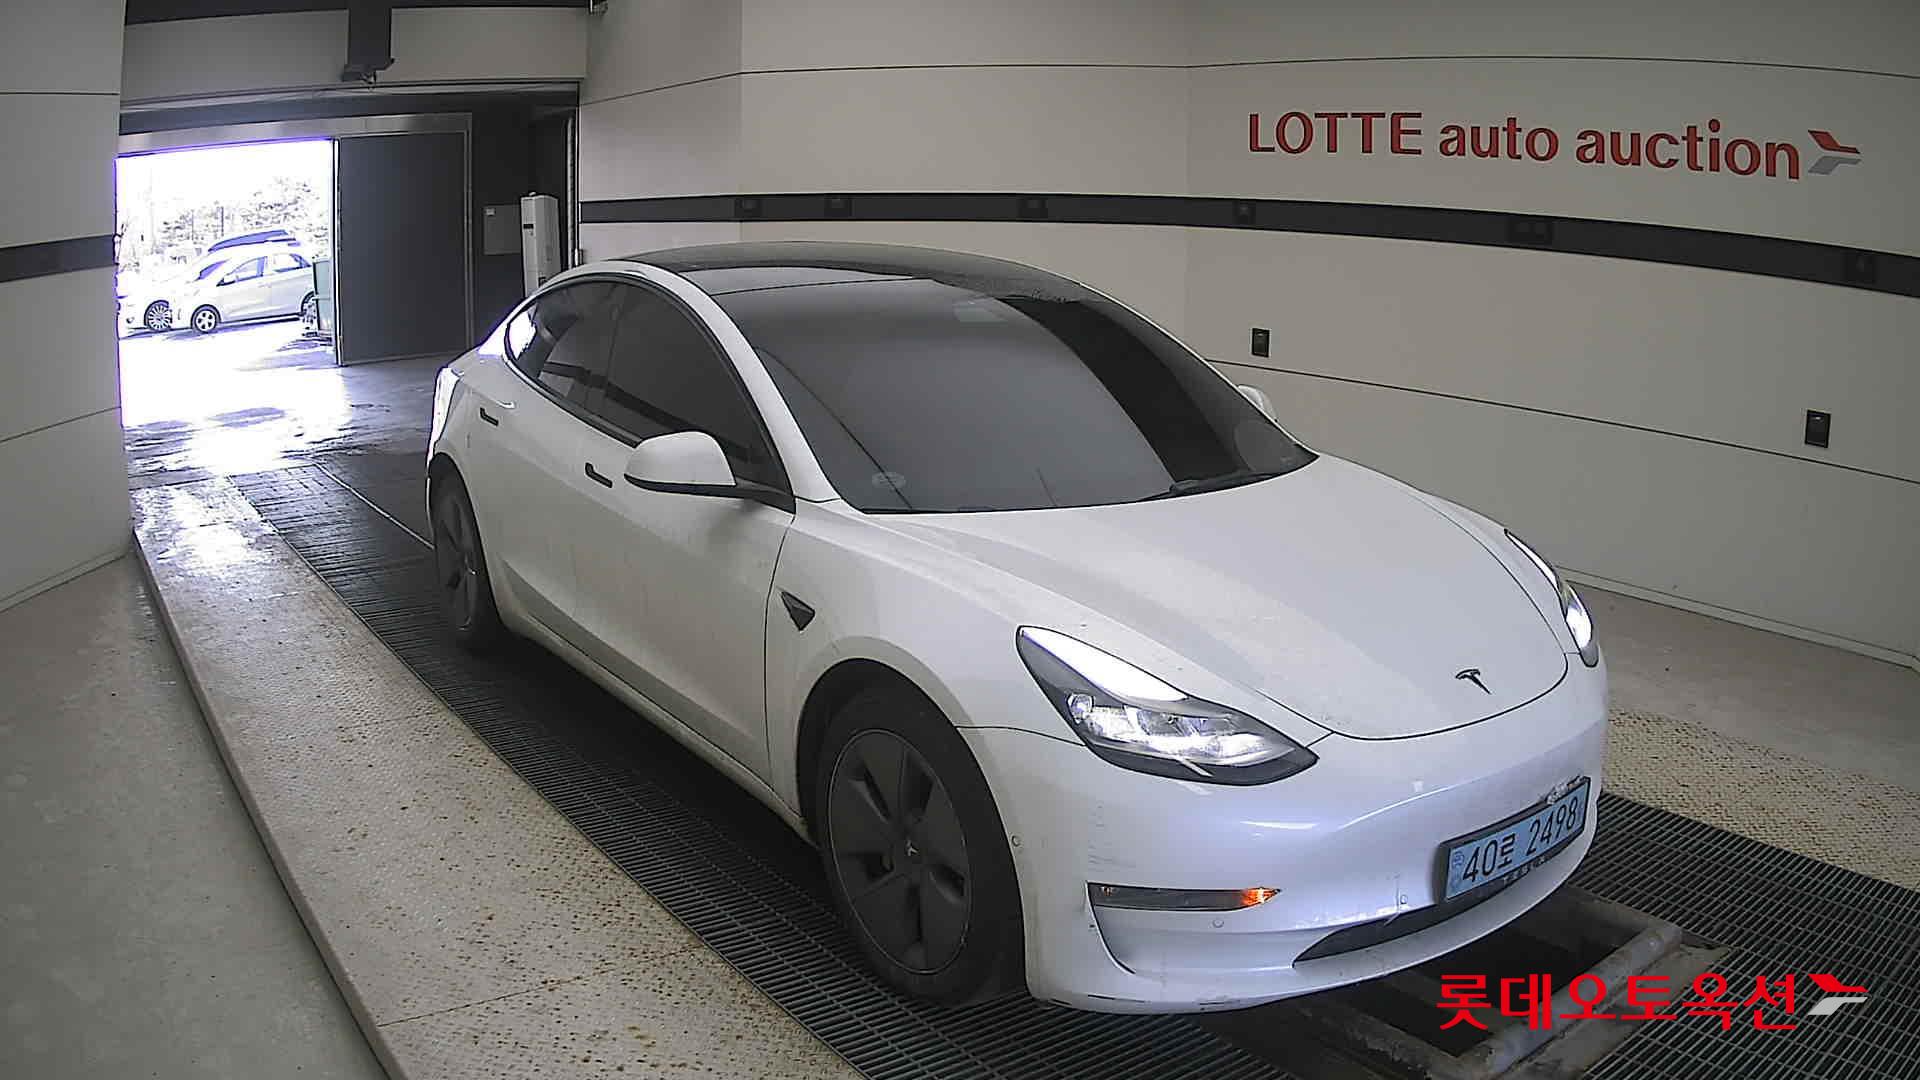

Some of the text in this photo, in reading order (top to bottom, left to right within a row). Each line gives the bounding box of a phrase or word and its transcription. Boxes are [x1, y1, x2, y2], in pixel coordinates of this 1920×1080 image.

[1248, 112, 1800, 180] LOTTE auto auction
[1462, 833, 1516, 883] 40로
[1525, 796, 1579, 857] 2498
